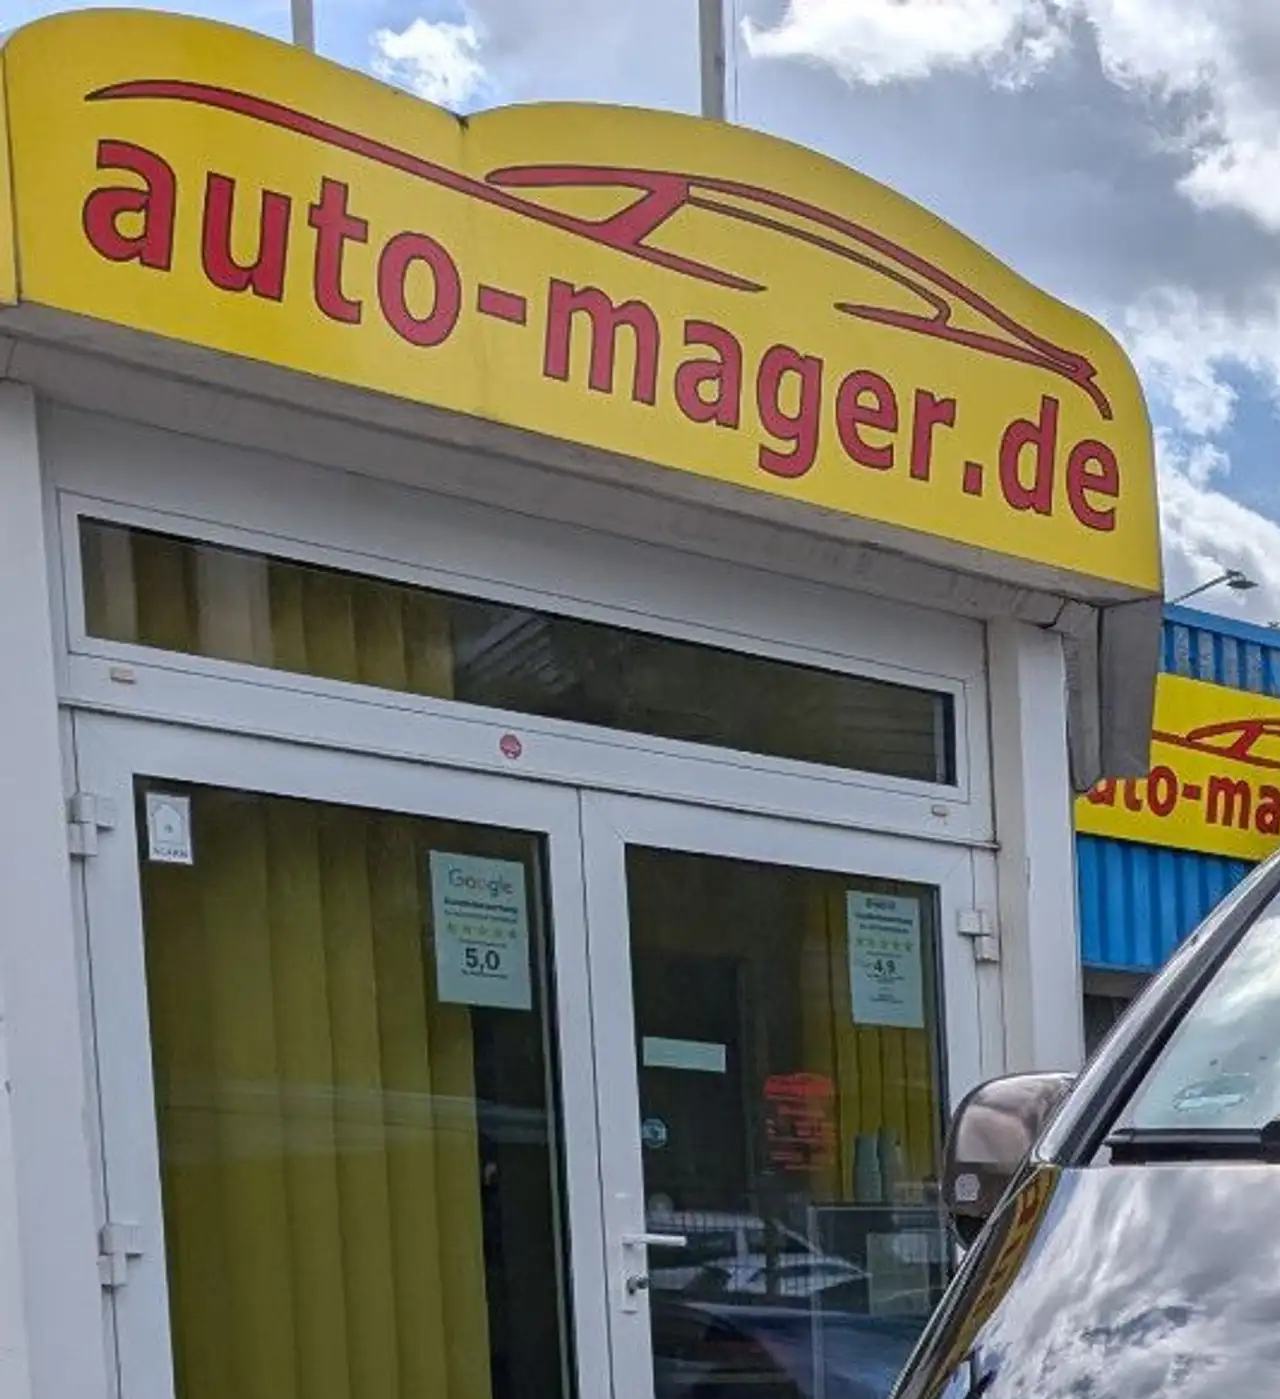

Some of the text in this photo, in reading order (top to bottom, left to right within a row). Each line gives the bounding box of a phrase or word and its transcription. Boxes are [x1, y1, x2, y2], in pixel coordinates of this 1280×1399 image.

[82, 138, 1119, 532] auto-mager.de
[448, 867, 514, 897] Google
[465, 948, 501, 973] 5,0
